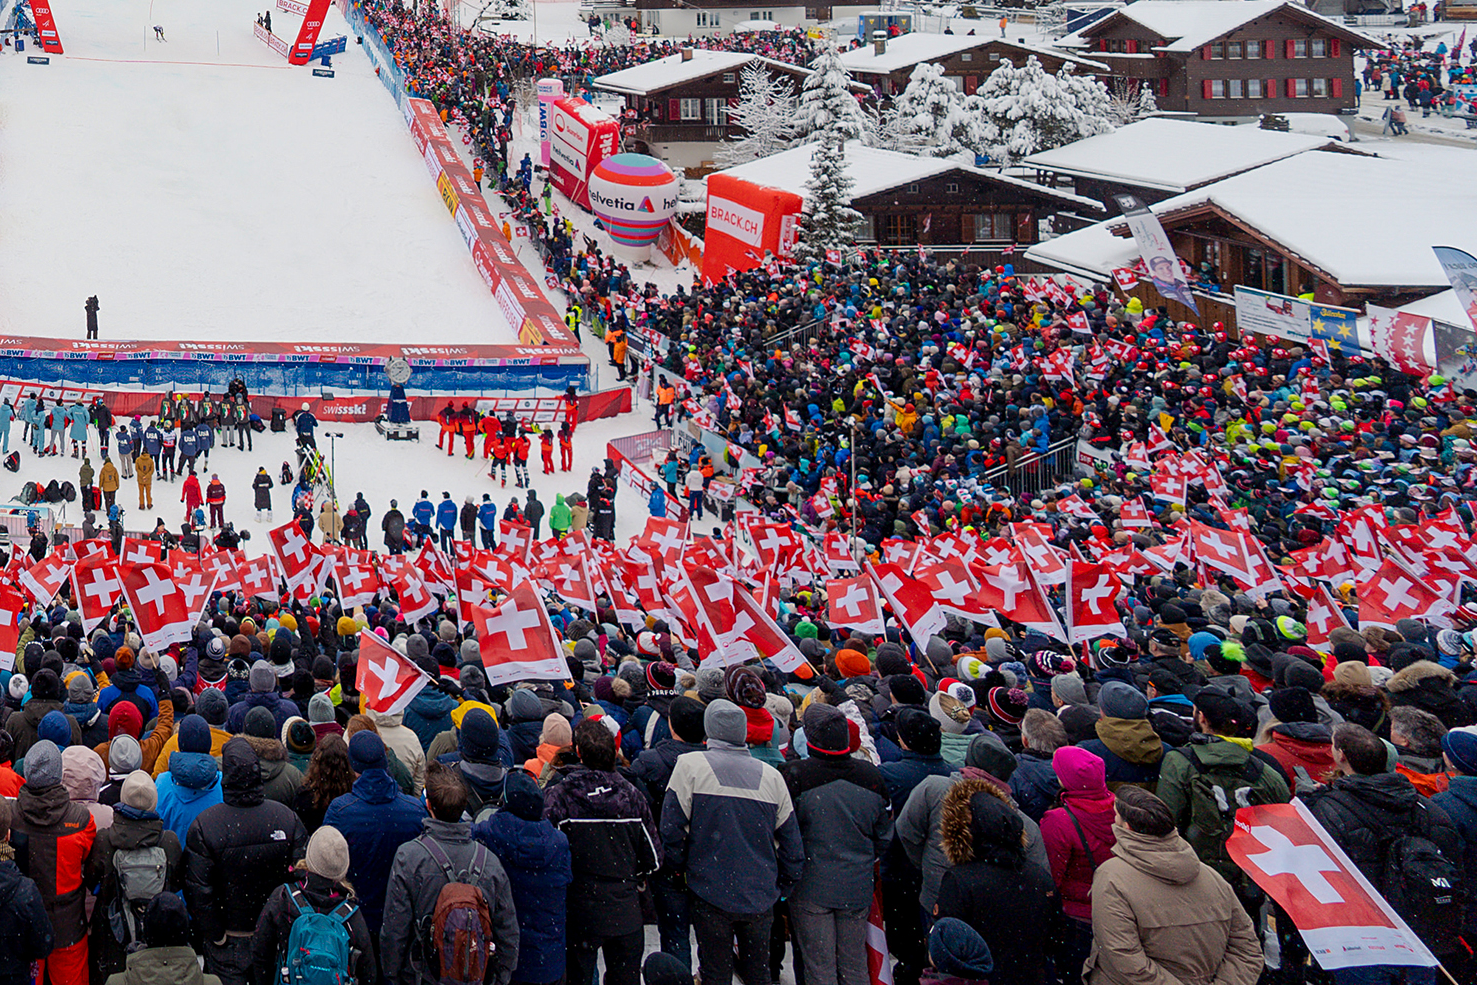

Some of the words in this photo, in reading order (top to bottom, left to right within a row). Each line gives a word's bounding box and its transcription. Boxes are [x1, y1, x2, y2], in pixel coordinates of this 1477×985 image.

[539, 101, 548, 128] BWT
[566, 126, 584, 142] Sunrise
[552, 144, 574, 166] helvetia
[470, 204, 492, 228] swissski
[711, 206, 758, 235] BRACK.CH
[490, 240, 515, 264] swissski
[511, 274, 539, 299] swissski
[537, 314, 568, 340] swissski
[72, 342, 138, 350] swissski
[178, 342, 244, 350] swissski
[294, 345, 360, 353] swissski
[400, 347, 468, 355] swissski
[515, 347, 580, 355] swissski
[418, 358, 436, 366] BWT
[450, 358, 468, 366] BWT
[512, 358, 531, 366] BWT
[322, 402, 367, 415] swissski
[146, 432, 158, 440] USA
